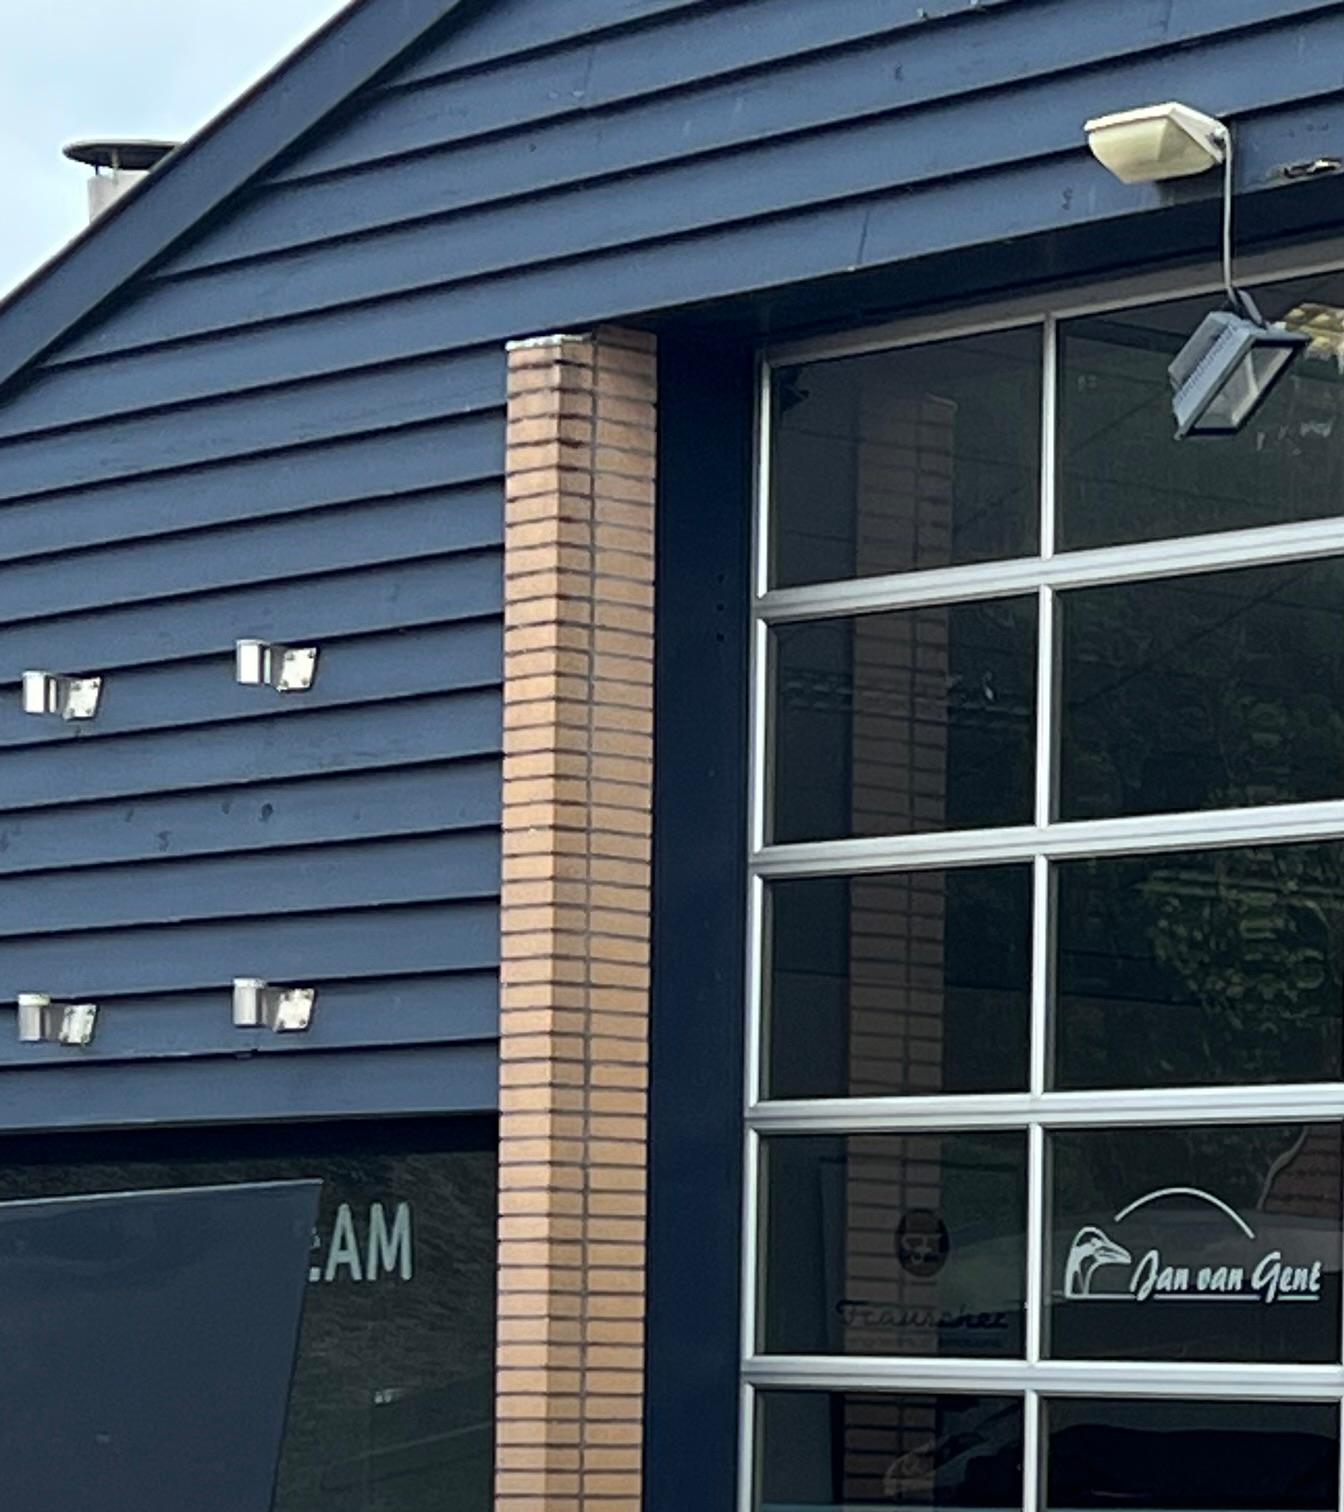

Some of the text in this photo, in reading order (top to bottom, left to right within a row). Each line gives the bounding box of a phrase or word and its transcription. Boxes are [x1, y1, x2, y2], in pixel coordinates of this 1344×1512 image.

[1130, 1249, 1322, 1303] Jan van Gent
